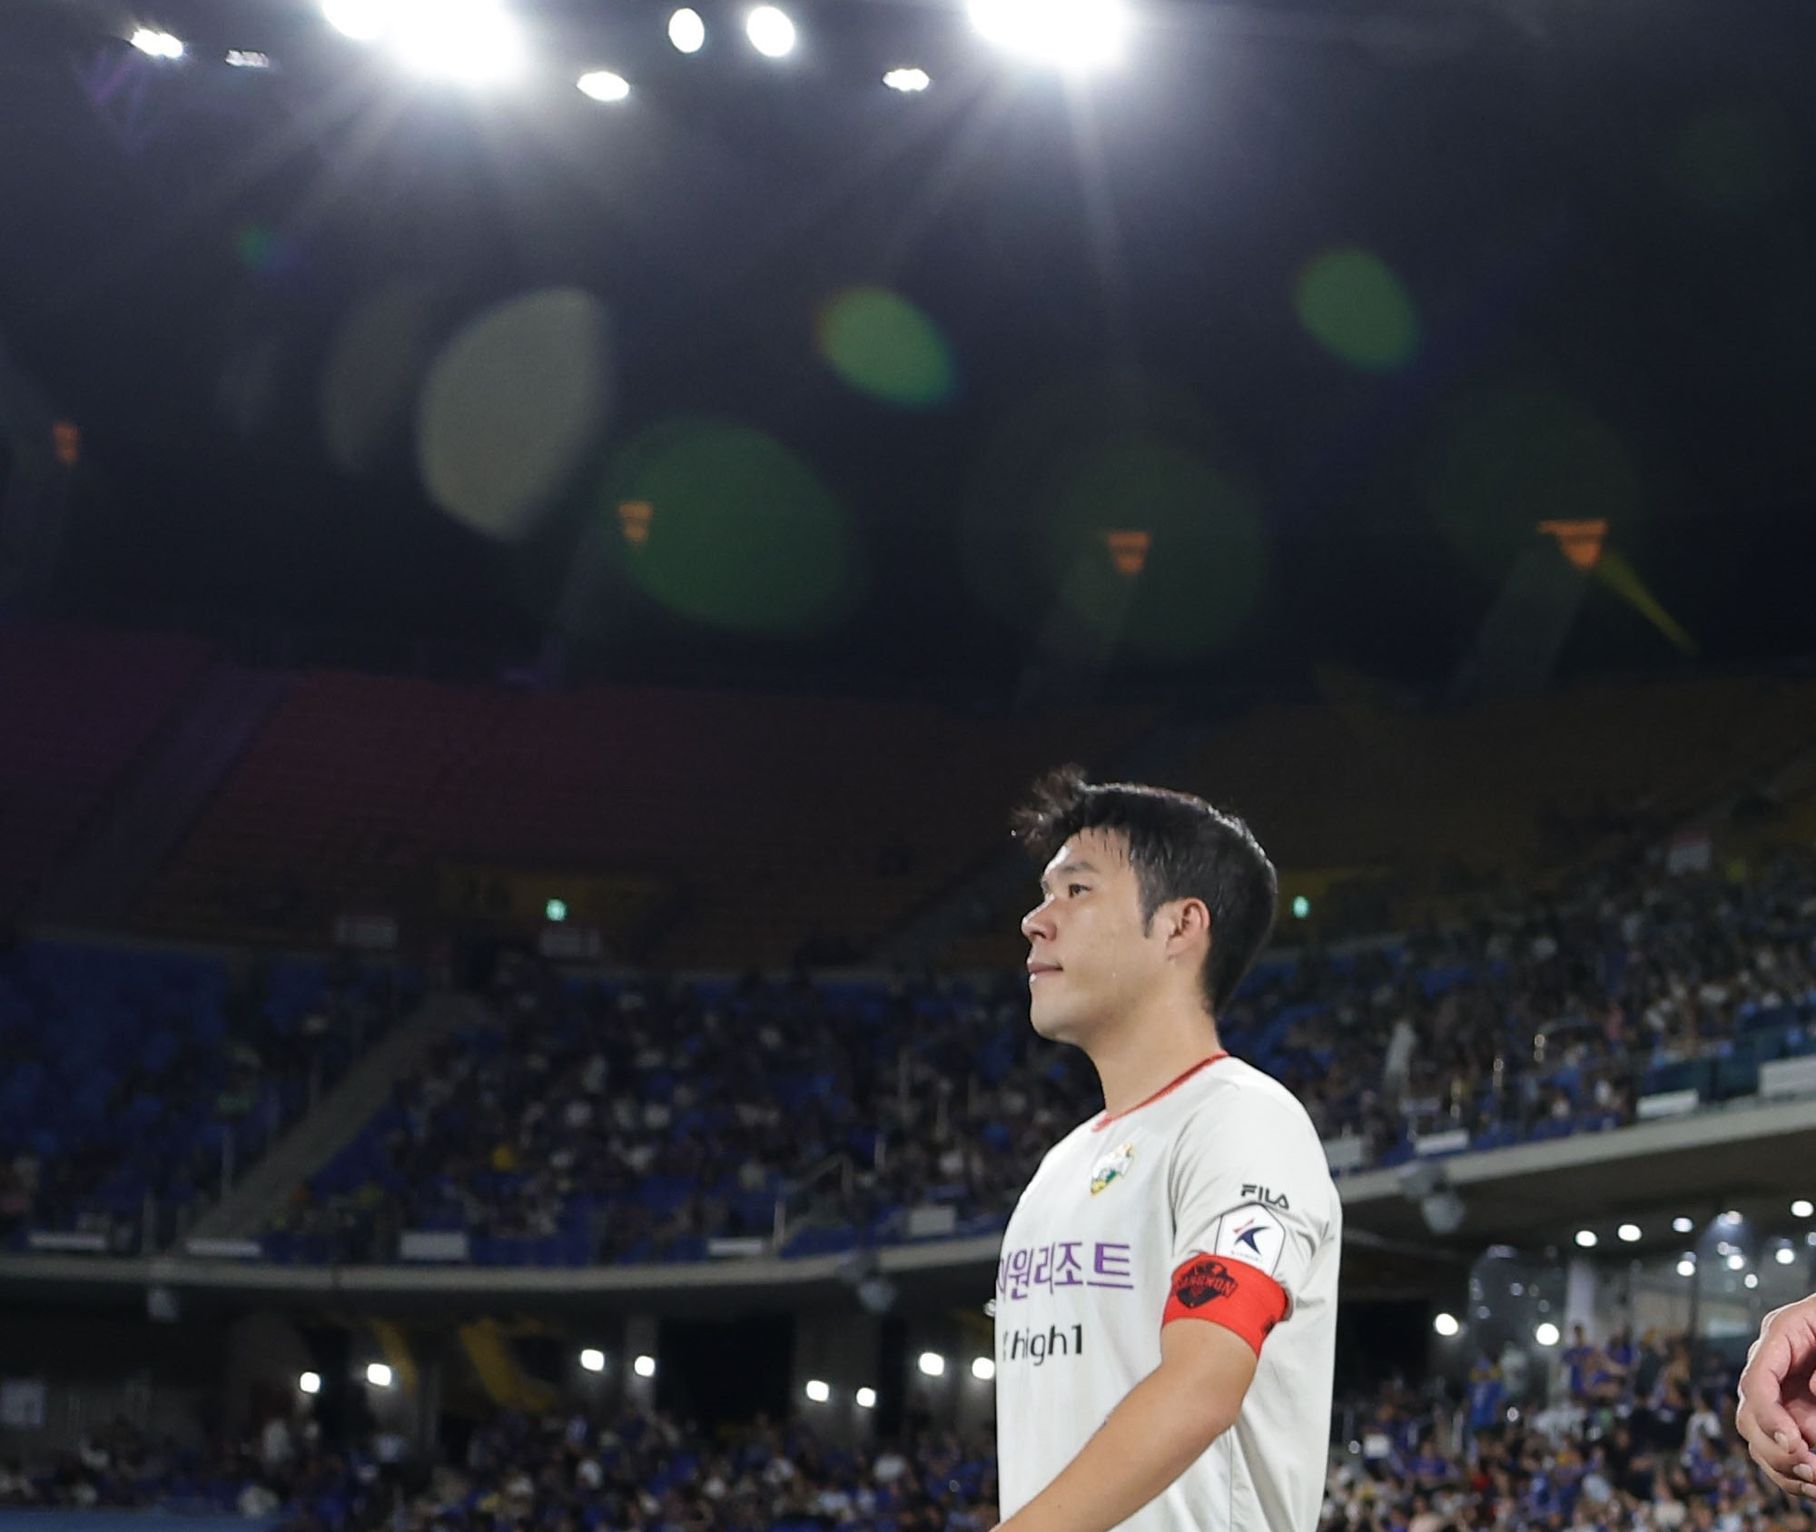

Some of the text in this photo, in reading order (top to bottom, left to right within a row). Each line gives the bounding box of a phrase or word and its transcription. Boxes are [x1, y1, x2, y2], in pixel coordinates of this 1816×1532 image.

[1240, 1184, 1289, 1210] FILA
[997, 1241, 1134, 1301] 이원리조트
[1011, 1324, 1083, 1366] high1
